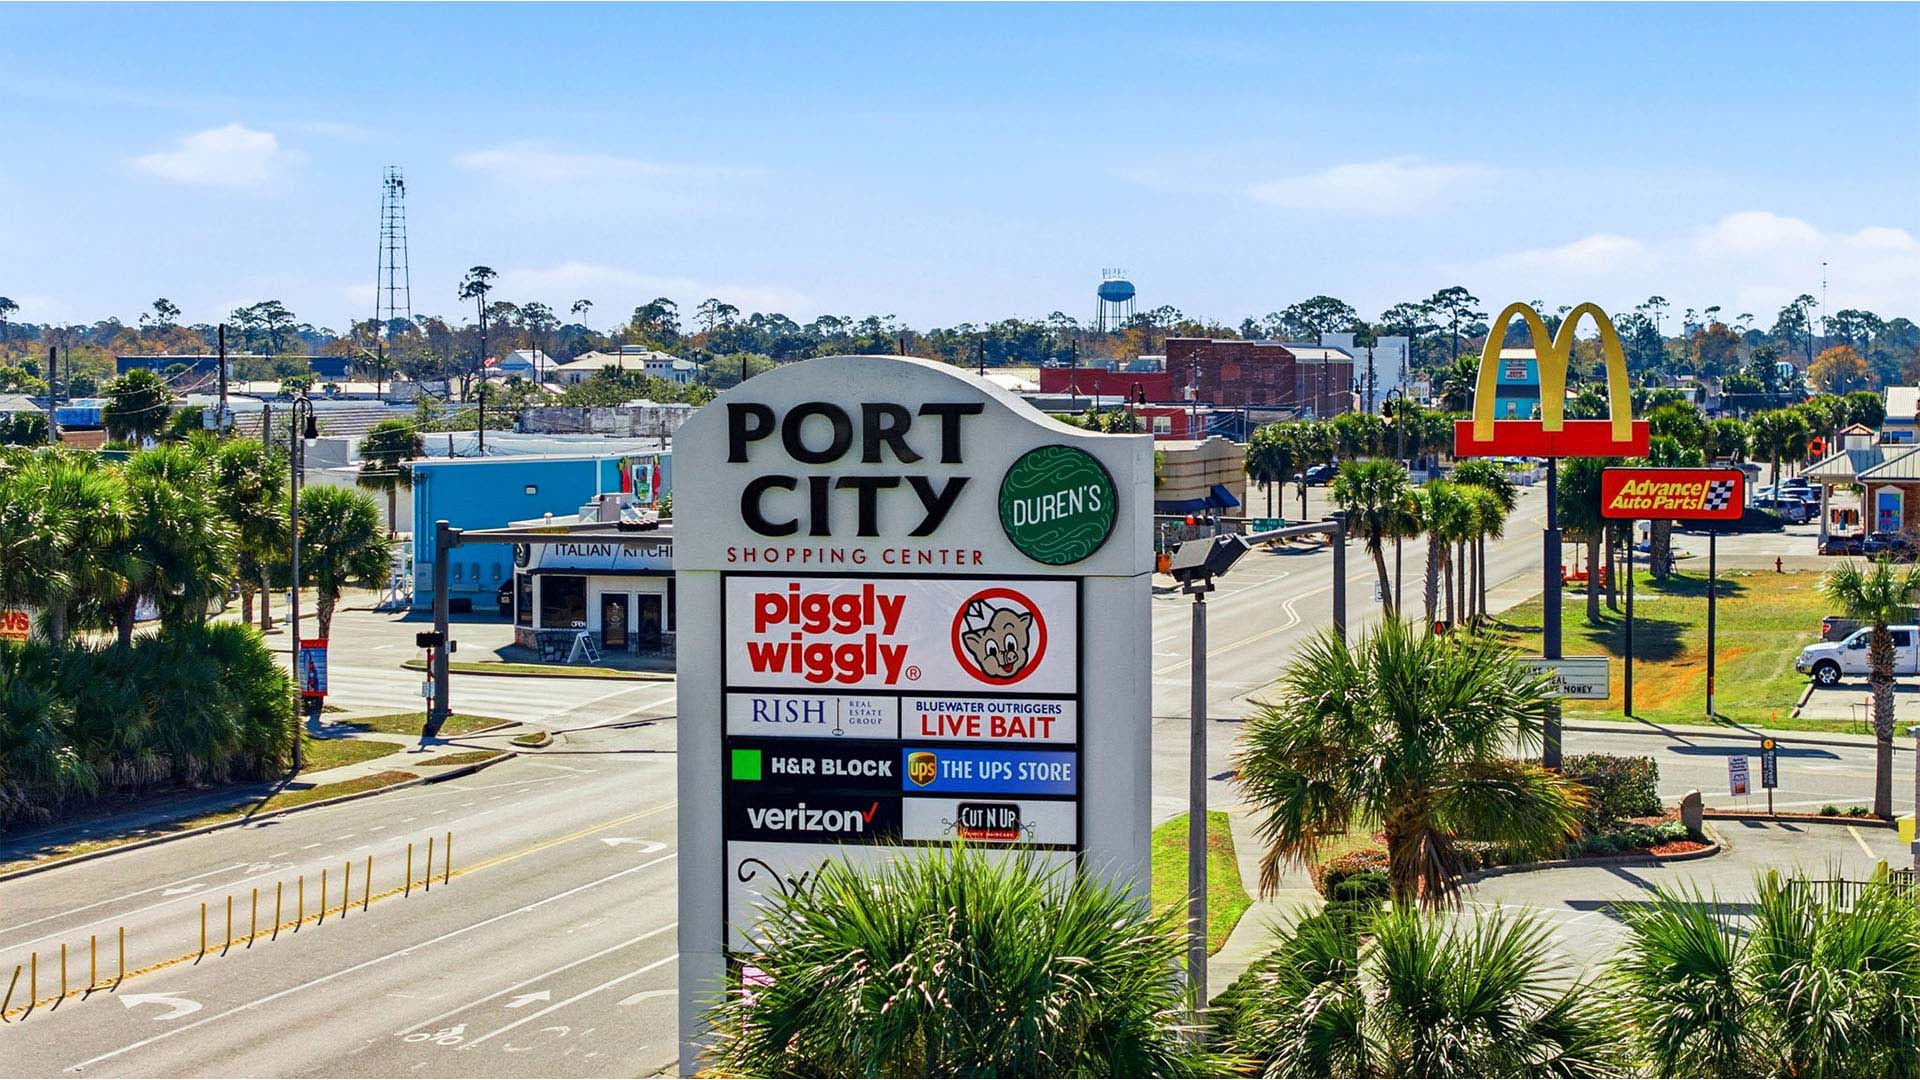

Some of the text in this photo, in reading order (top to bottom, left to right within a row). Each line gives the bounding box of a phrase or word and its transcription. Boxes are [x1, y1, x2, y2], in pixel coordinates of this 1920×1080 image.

[726, 402, 985, 464] PORT
[1619, 480, 1702, 496] Advance
[740, 475, 971, 537] CITY
[1013, 484, 1101, 527] DUREN'S
[1609, 496, 1699, 510] Auto Parts
[555, 543, 673, 558] ITALIAN KITCH
[727, 547, 985, 565] SHOPPING CENTER
[754, 583, 907, 634] piggly
[747, 633, 909, 685] wiggly
[751, 699, 826, 724] RISH
[915, 701, 1062, 715] BLUEWATER OUTRIGGERS
[921, 715, 1056, 739] LIVE BAIT
[771, 757, 893, 777] H&R BLOCK
[910, 761, 936, 780] ups
[941, 760, 1072, 782] THE UPS STORE
[747, 802, 864, 832] verizon
[961, 807, 1016, 828] CUT N UP
